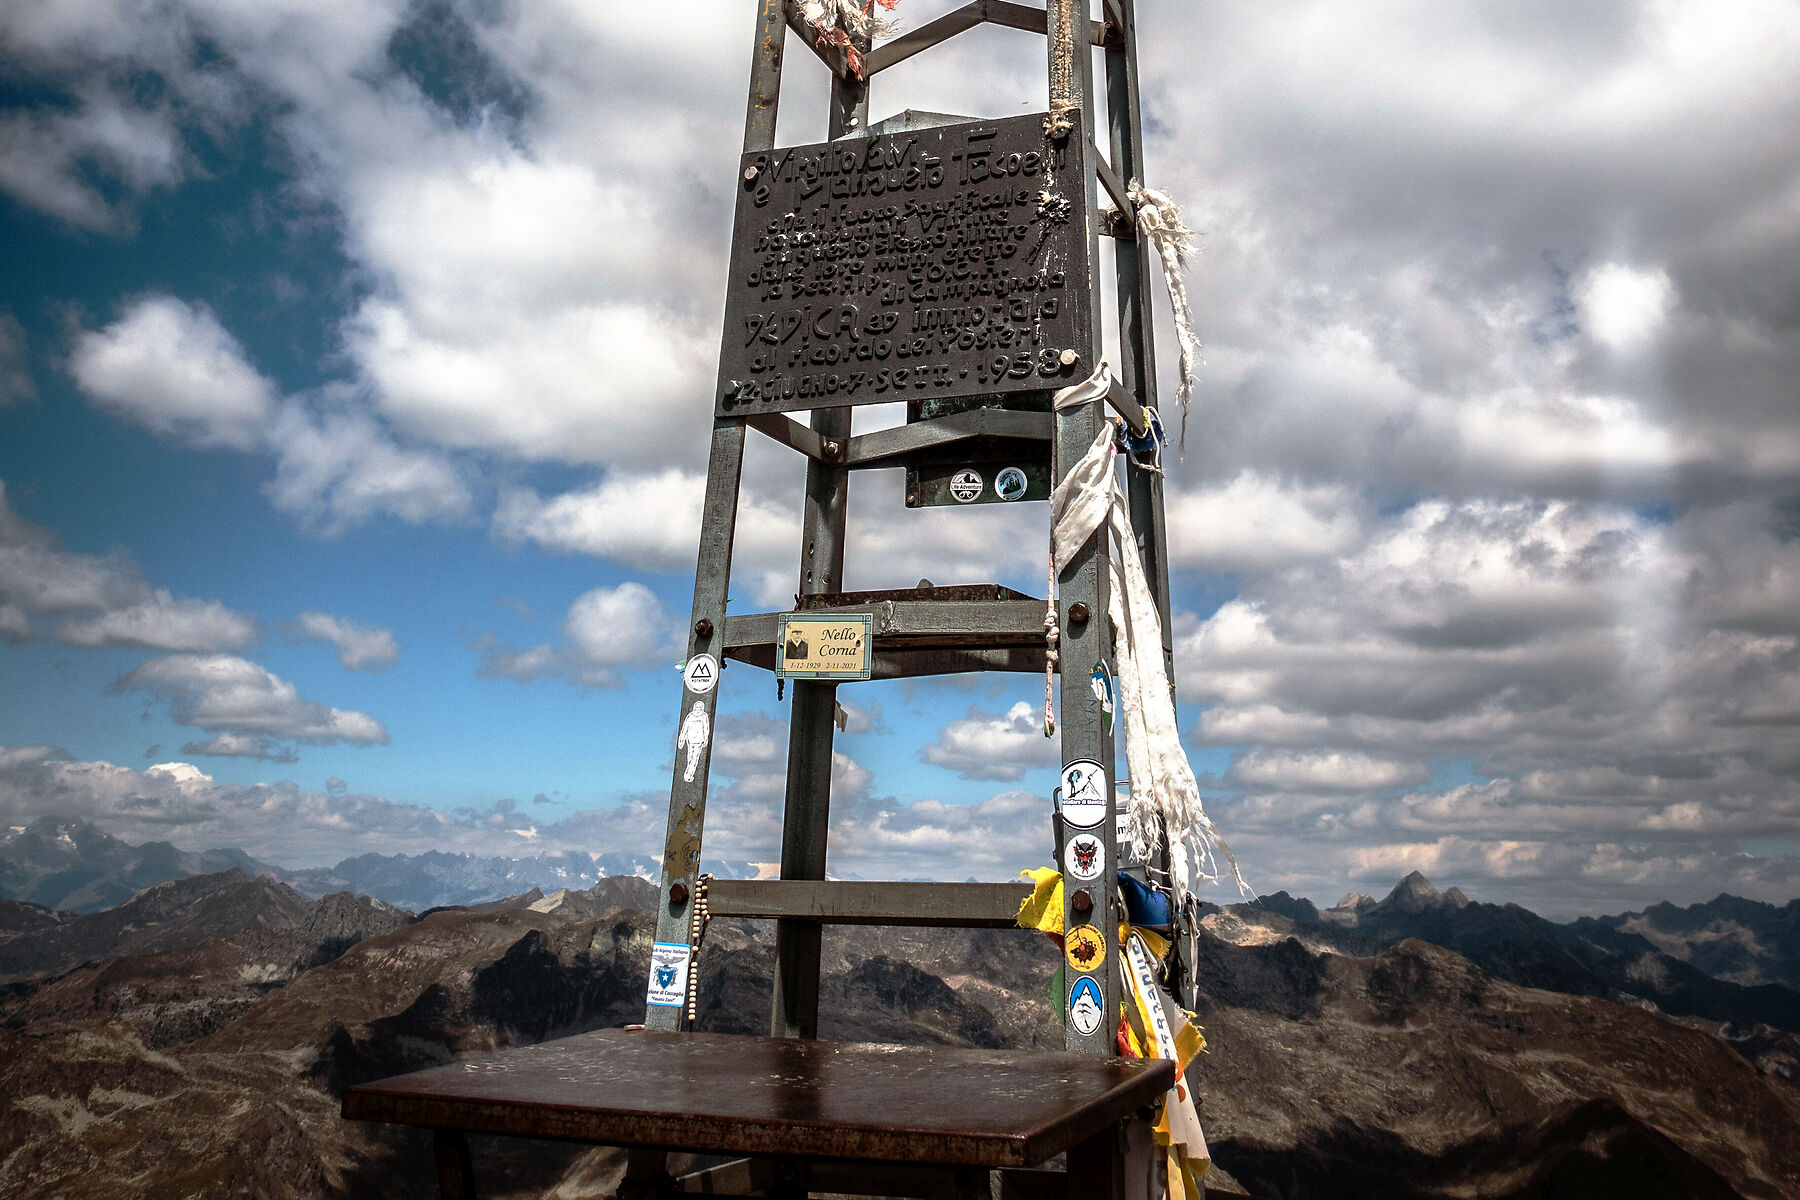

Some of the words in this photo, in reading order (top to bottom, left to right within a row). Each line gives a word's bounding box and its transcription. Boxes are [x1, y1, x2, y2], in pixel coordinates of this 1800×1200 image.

[788, 338, 892, 368] ricordo
[821, 628, 856, 641] Nello
[819, 644, 857, 657] Corna
